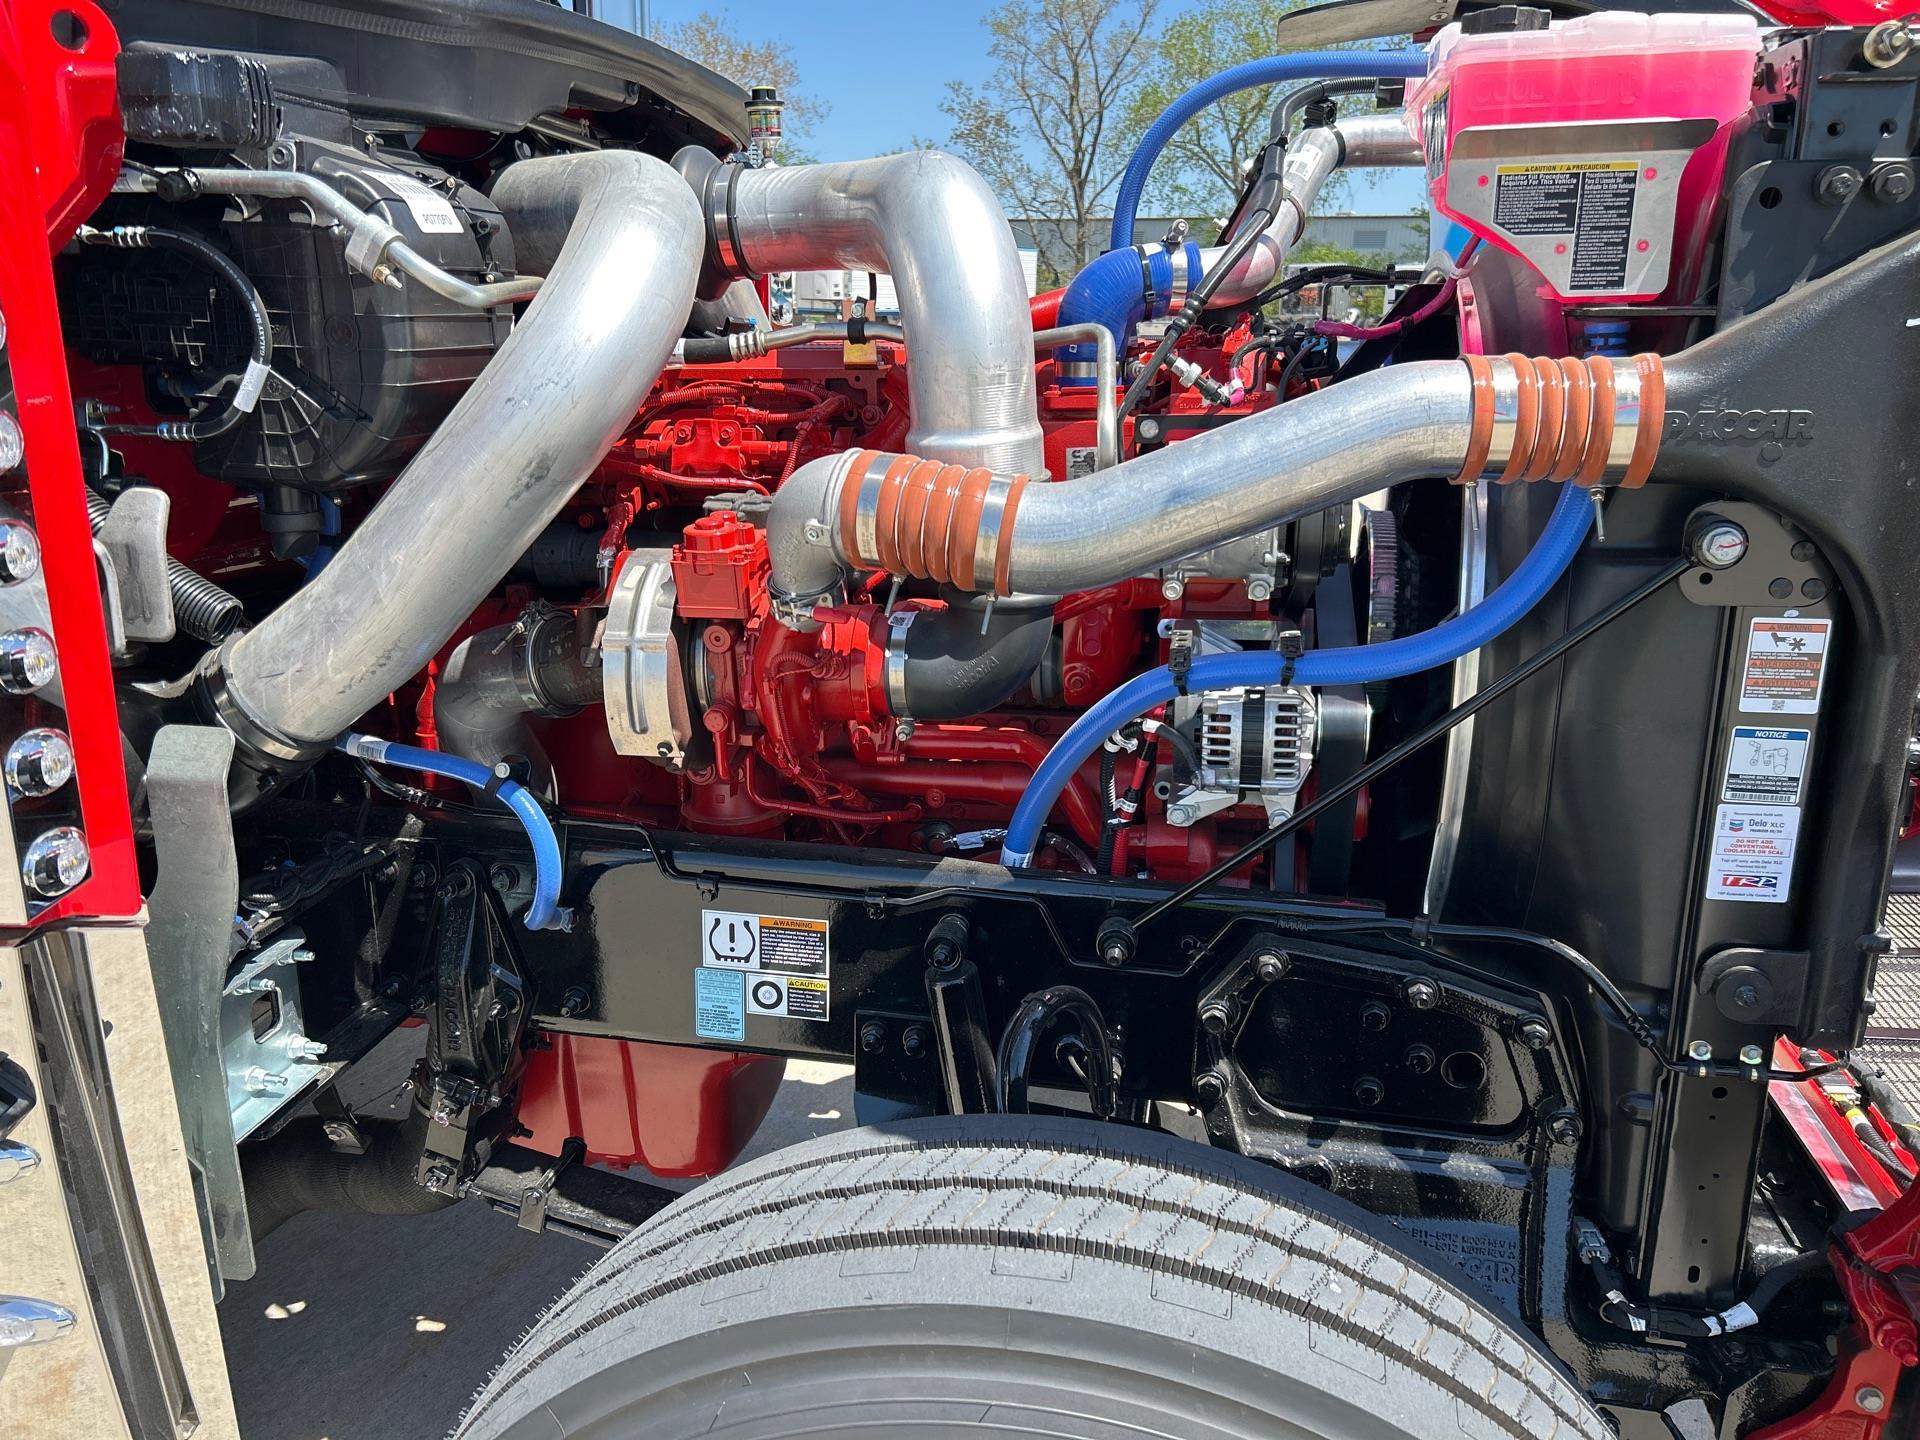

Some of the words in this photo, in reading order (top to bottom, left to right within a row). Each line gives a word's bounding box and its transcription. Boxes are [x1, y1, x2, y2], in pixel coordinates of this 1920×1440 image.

[1654, 409, 1815, 440] PACCAR
[1749, 819, 1767, 827] Delo
[1722, 875, 1778, 888] TRP
[779, 920, 812, 928] WARNING
[795, 981, 826, 989] CAUTION
